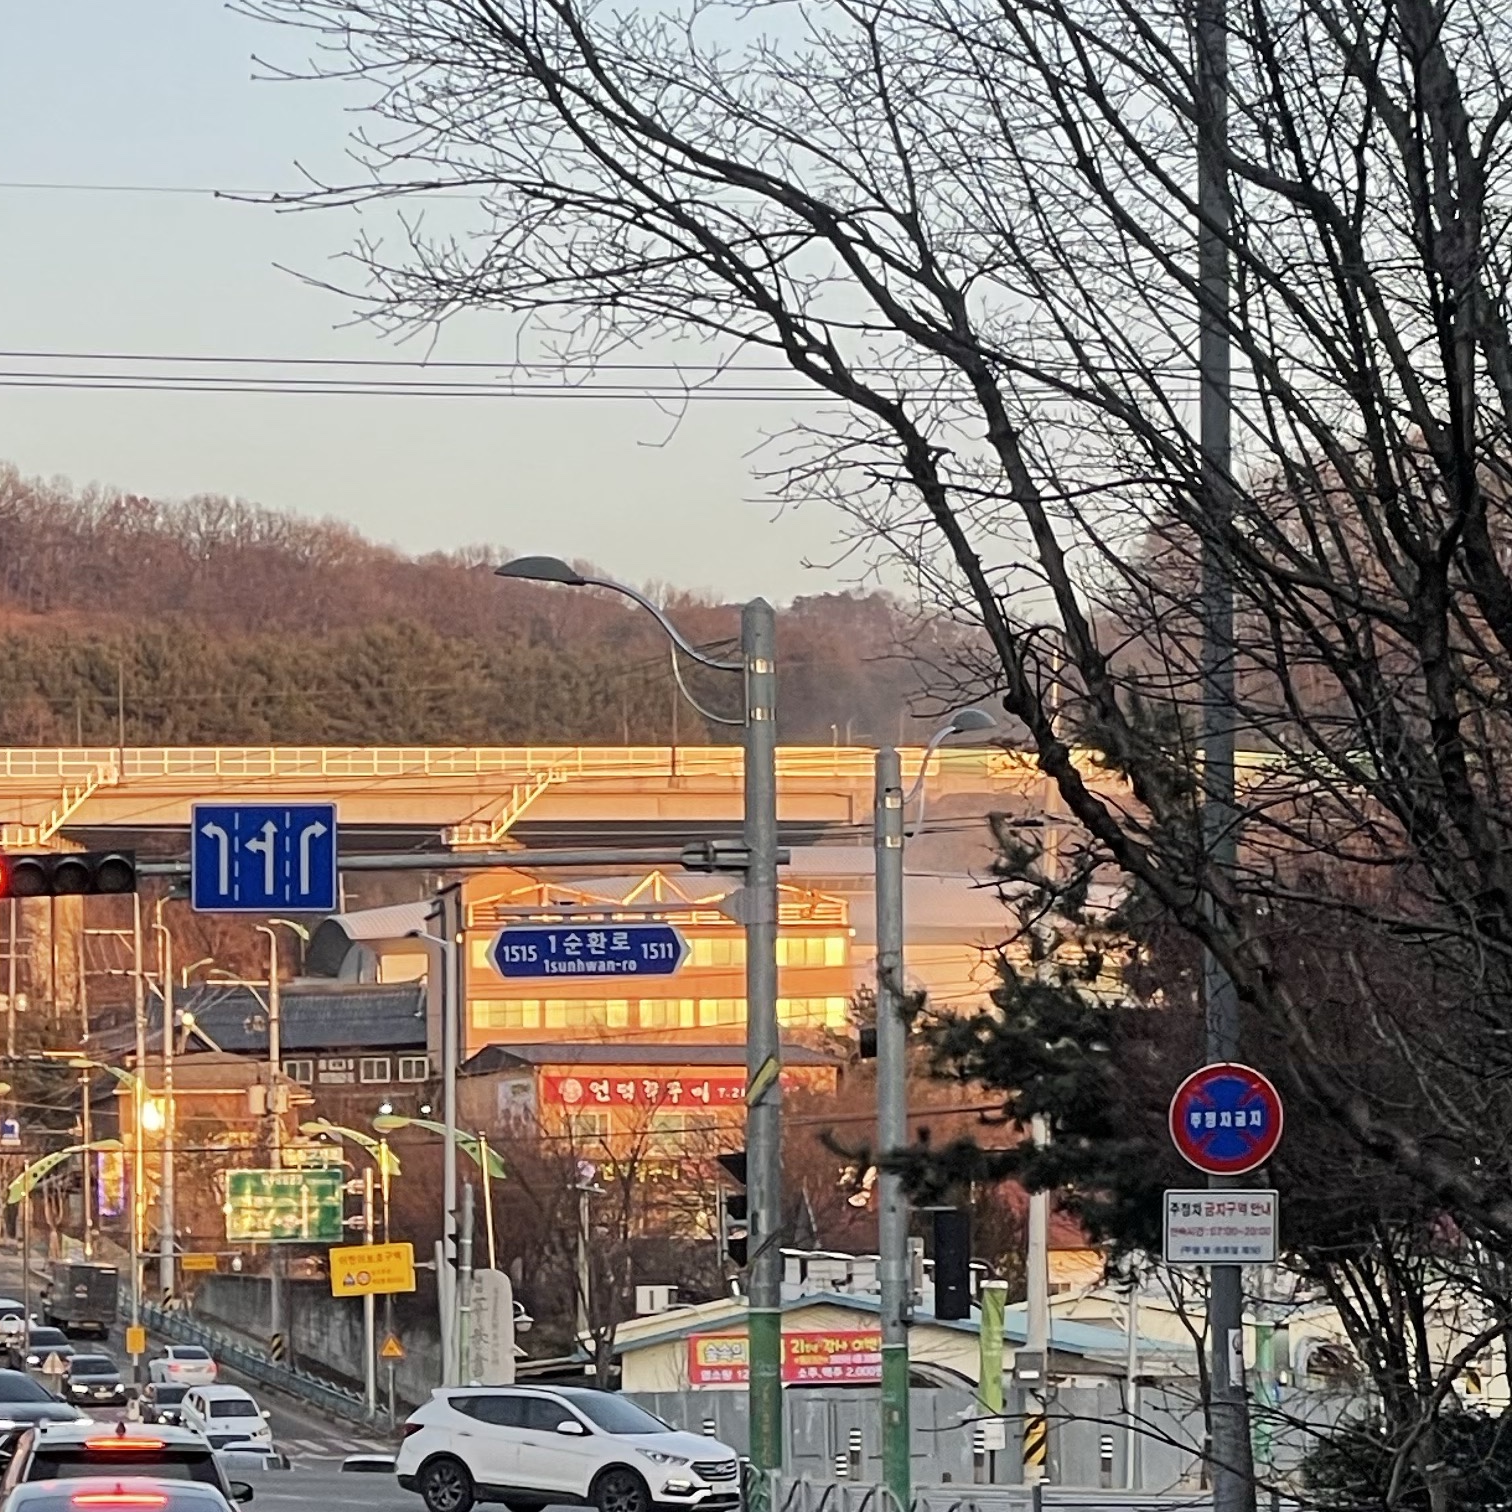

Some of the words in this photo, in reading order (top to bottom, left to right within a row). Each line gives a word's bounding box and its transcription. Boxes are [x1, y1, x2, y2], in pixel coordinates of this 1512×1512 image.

[502, 945, 538, 963] 1515
[641, 942, 674, 960] 1511
[543, 958, 637, 974] 1sunhwan-ro
[1190, 1109, 1262, 1129] 주정차금지
[1170, 1201, 1202, 1217] 주정차
[1204, 1201, 1248, 1217] 금지구역
[1250, 1201, 1271, 1217] 안내
